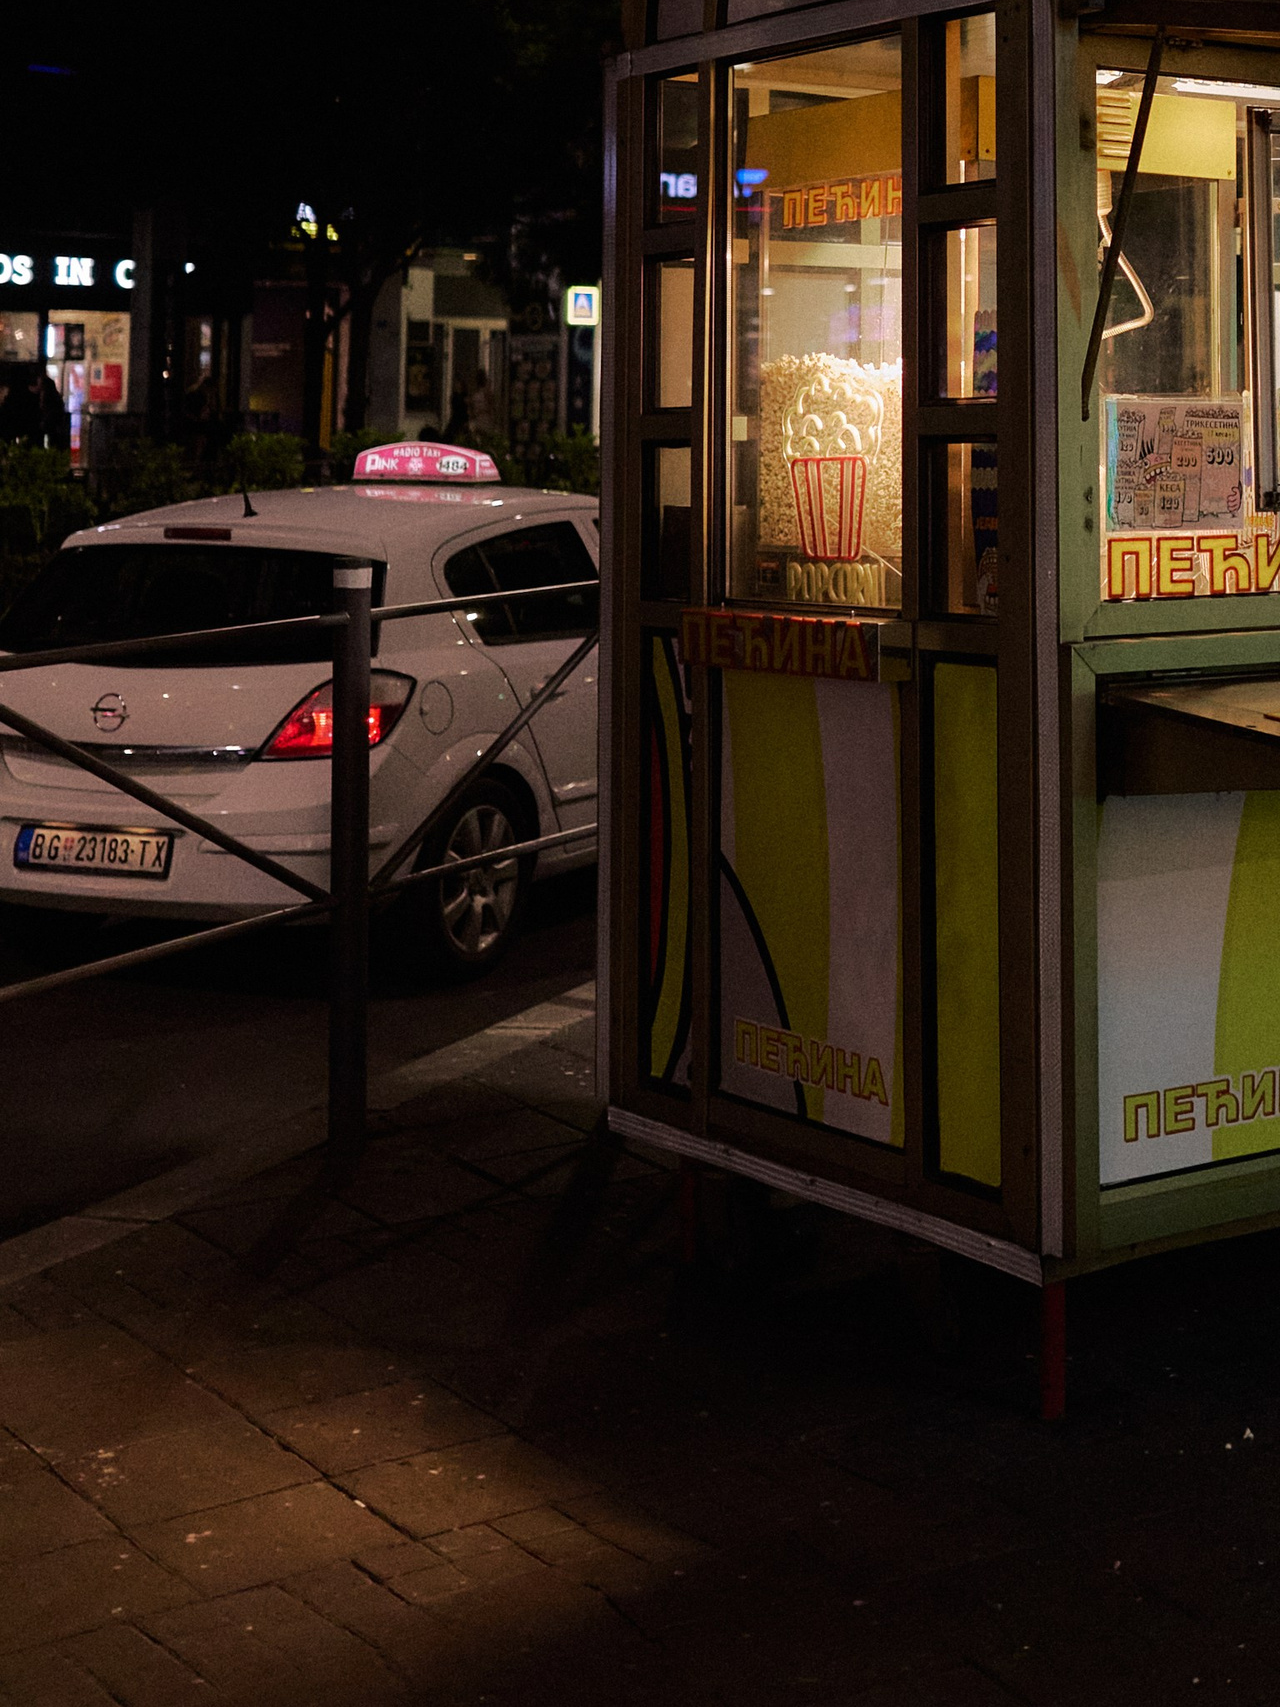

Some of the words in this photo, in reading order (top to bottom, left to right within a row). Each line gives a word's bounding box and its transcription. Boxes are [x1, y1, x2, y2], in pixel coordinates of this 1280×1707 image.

[783, 177, 902, 229] ПЕЋИН
[55, 256, 94, 286] IN
[366, 454, 399, 474] PINK
[393, 447, 420, 458] RADIO
[423, 447, 440, 458] TAXI
[787, 561, 883, 608] POPCORN
[682, 610, 870, 680] ПЕЋИНА
[32, 833, 61, 861] BG
[735, 1019, 889, 1107] ПЕЋИНА
